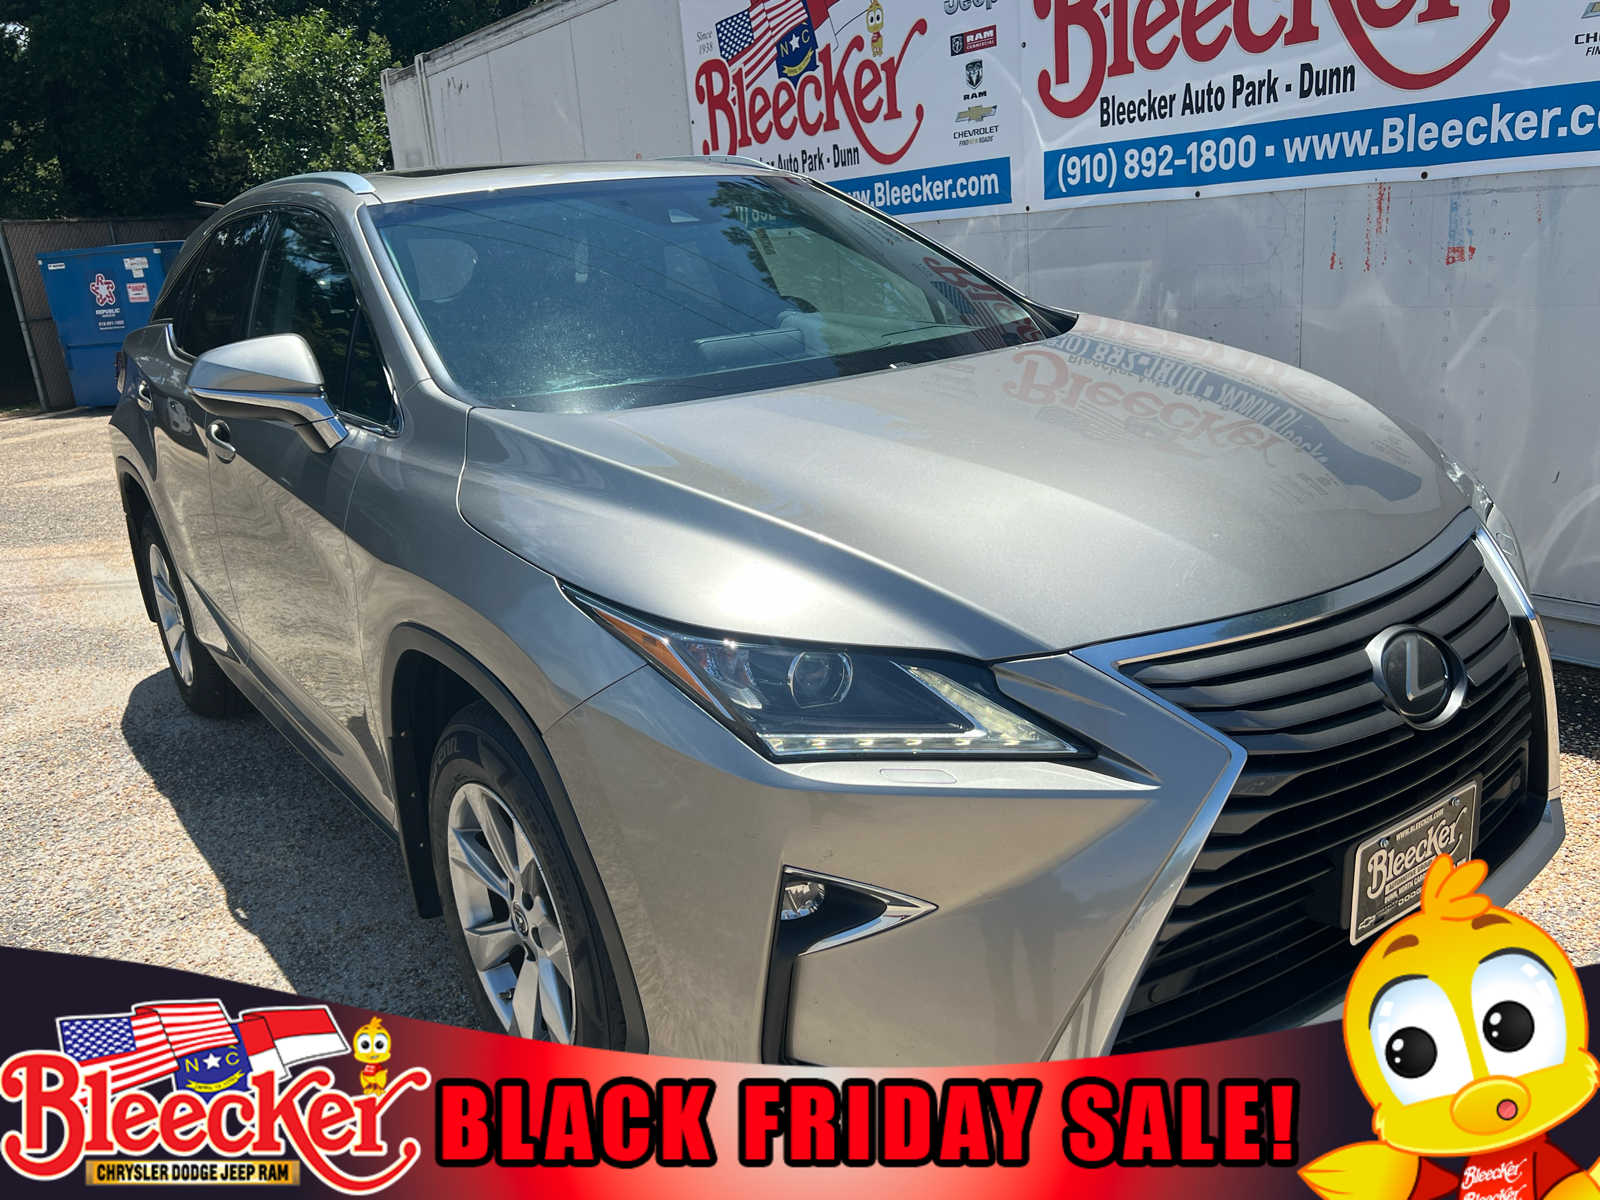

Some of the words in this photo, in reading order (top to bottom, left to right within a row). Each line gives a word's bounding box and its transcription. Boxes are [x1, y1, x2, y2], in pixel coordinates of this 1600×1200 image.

[966, 30, 994, 43] RAM
[695, 17, 927, 165] Bleecker
[963, 91, 987, 100] RAM
[1100, 90, 1176, 128] Bleecker
[1181, 80, 1225, 118] Auto
[1232, 69, 1279, 109] Park
[1299, 62, 1355, 99] Dunn
[953, 125, 999, 139] CHEVROLET
[1057, 152, 1118, 193] (910)
[1124, 134, 1256, 180] 892-1800
[1284, 103, 1600, 164] www.Bleecker.c
[801, 147, 824, 173] Park
[832, 144, 859, 168] Dunn
[1367, 806, 1468, 900] Bleecker
